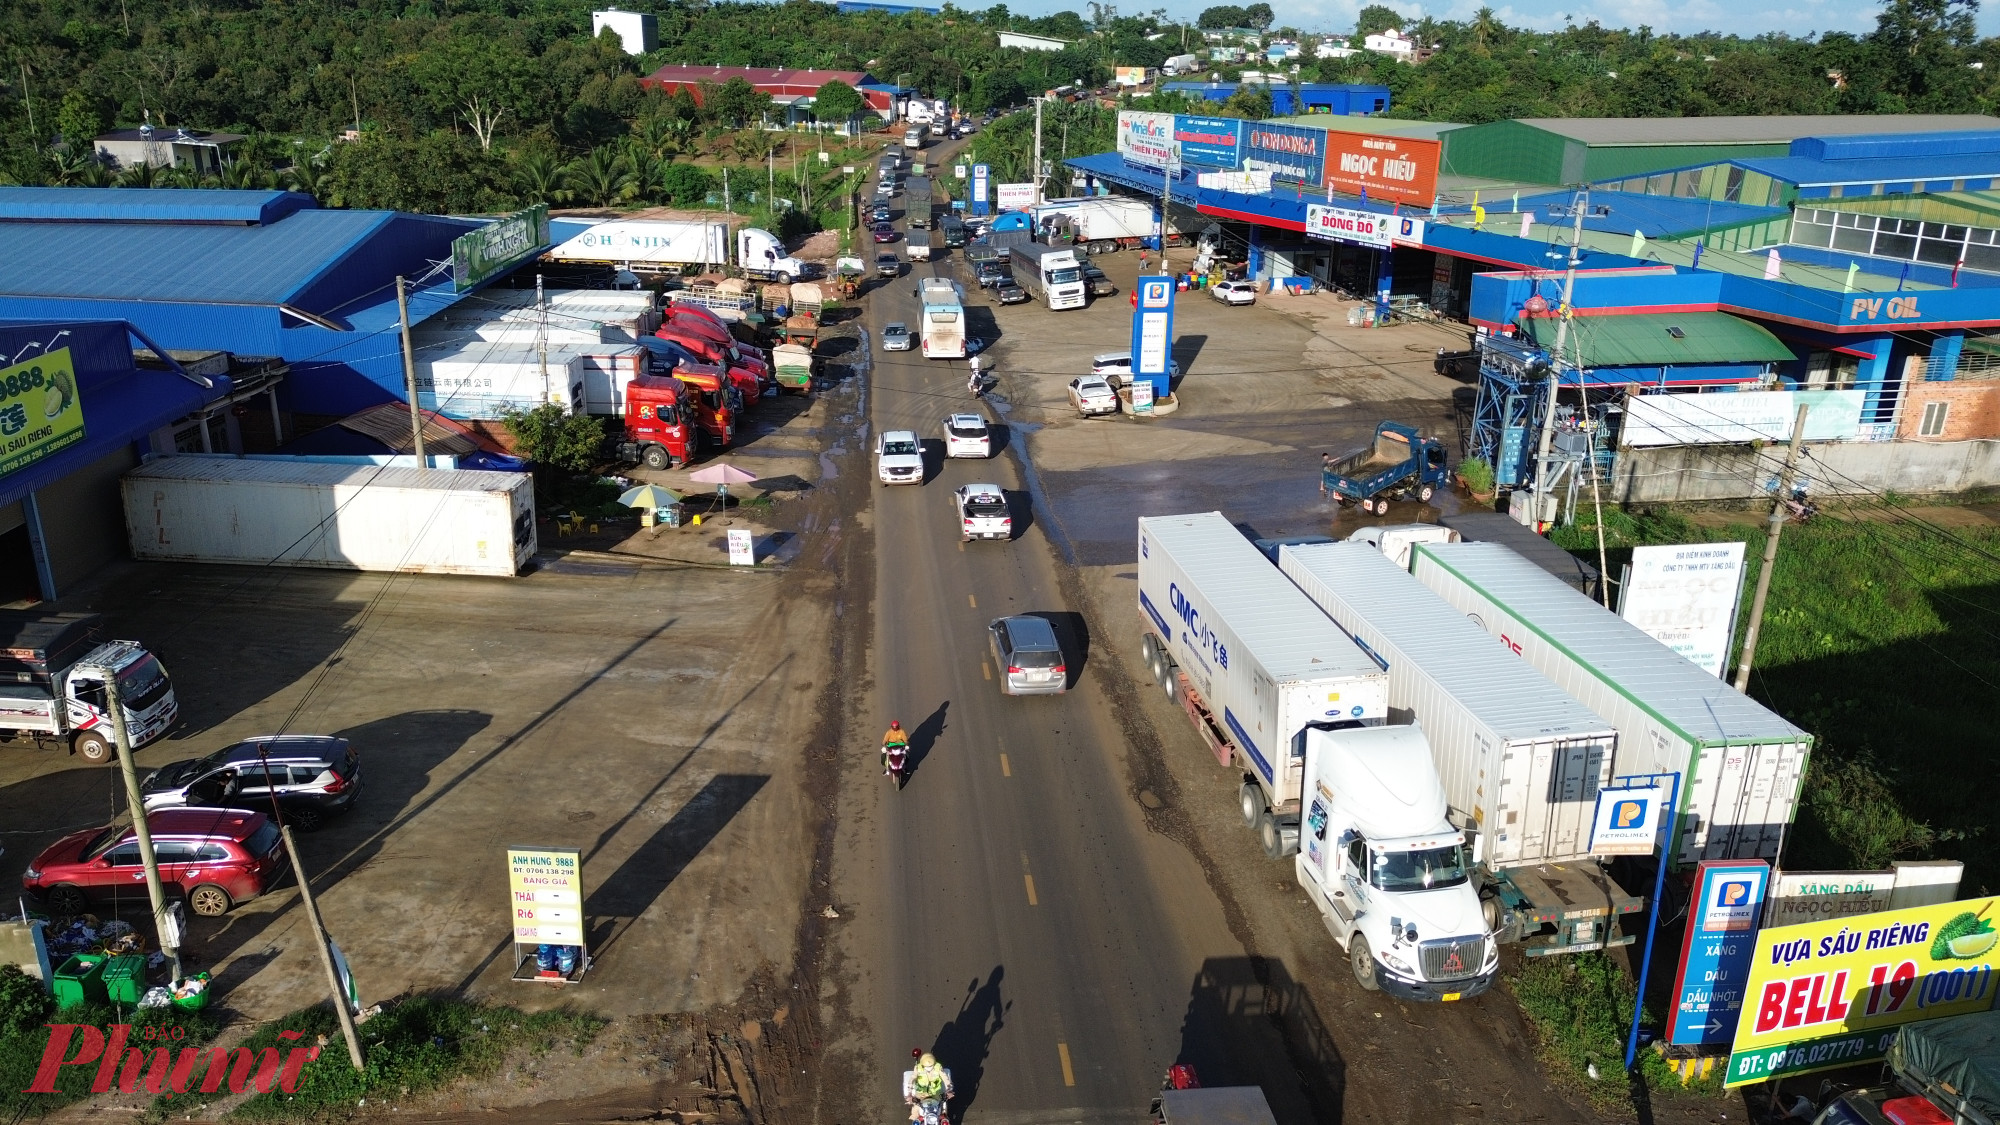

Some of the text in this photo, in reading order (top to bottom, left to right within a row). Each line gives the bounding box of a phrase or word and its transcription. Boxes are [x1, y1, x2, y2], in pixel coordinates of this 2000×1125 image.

[1340, 152, 1417, 182] NGỌC HIẾU
[1322, 214, 1374, 234] ĐÔNG ĐÔ
[1850, 297, 1922, 320] PV OIL
[1169, 582, 1199, 638] CIMC
[513, 855, 529, 865] ANH
[555, 857, 574, 867] 9888
[1799, 880, 1875, 895] XĂNG DẦU
[1782, 894, 1883, 915] NGỌC HIẾU
[1705, 943, 1737, 957] XĂNG
[1771, 922, 1929, 967] VỰA SẦU RIÊNG
[1704, 967, 1728, 981] DẦU
[1686, 987, 1737, 1003] DẦU NHỚT
[1754, 960, 1991, 1034] BELL 19 (001)
[1739, 1053, 1762, 1076] ĐT:
[1767, 1037, 1864, 1071] 0976.027779
